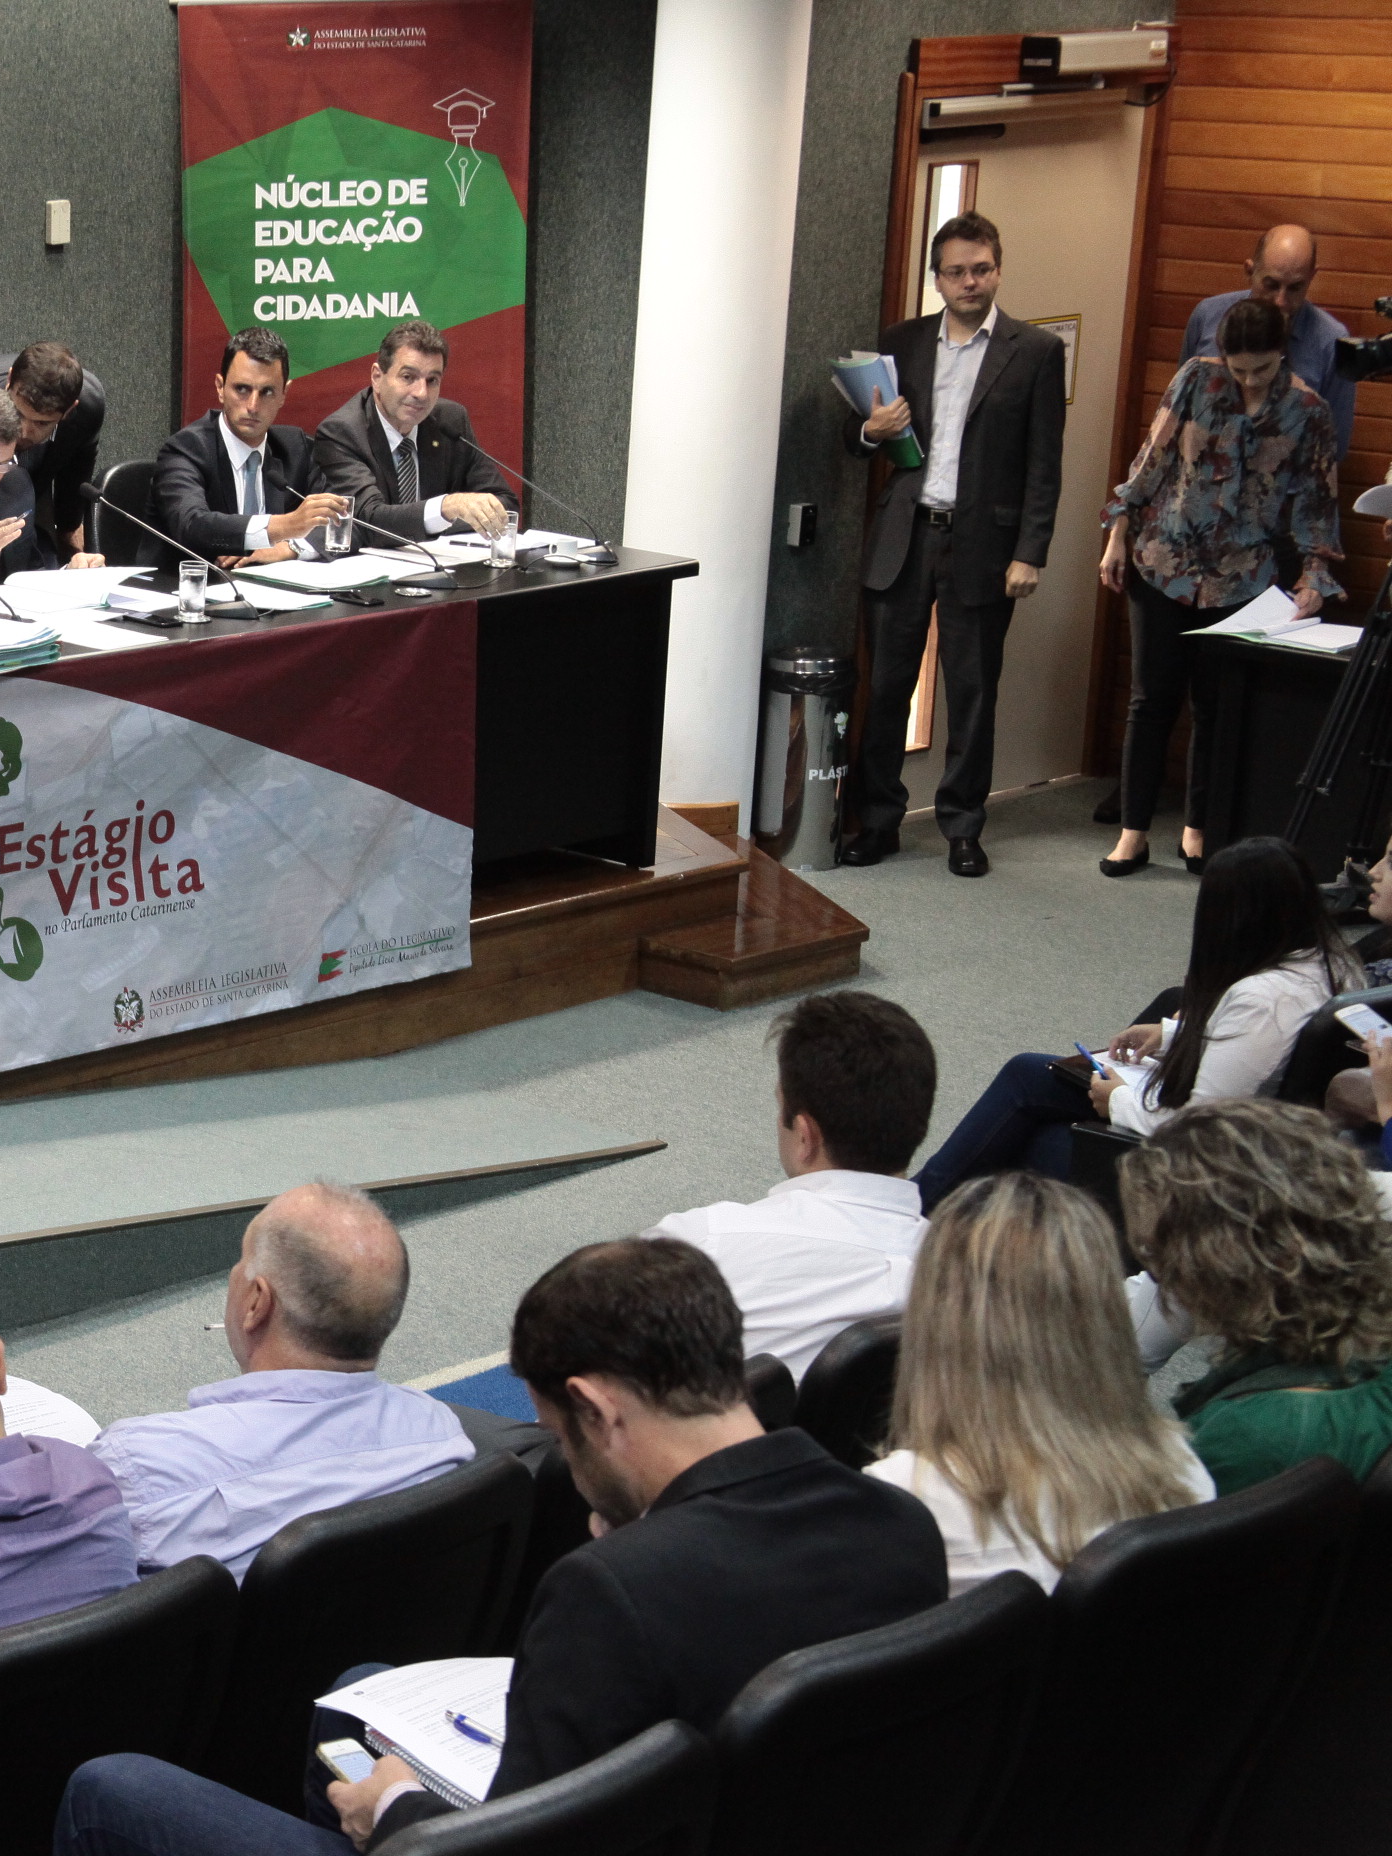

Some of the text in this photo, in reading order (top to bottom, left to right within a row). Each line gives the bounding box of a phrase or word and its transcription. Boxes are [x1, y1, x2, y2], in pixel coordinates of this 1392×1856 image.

[313, 41, 325, 49] DO
[327, 41, 354, 49] ESTADO
[367, 40, 389, 48] SANTA
[391, 39, 427, 47] CATARINA
[314, 27, 427, 39] ASSEMBLEIA LEGISLATIVA
[254, 174, 428, 210] NÚCLEO DE
[254, 210, 423, 252] EDUCAÇÃO
[254, 256, 335, 284] PARA
[253, 291, 421, 322] CIDADANIA
[47, 852, 205, 916] Visita
[44, 898, 196, 936] no Parlamento Catarinense
[349, 925, 456, 958] ESCOLA DO LEGISLATIVO
[149, 962, 287, 1003] ASSEMBLEIA LEGISLATIVA
[149, 980, 289, 1019] DO ESTADO DE SANTA CATARINA
